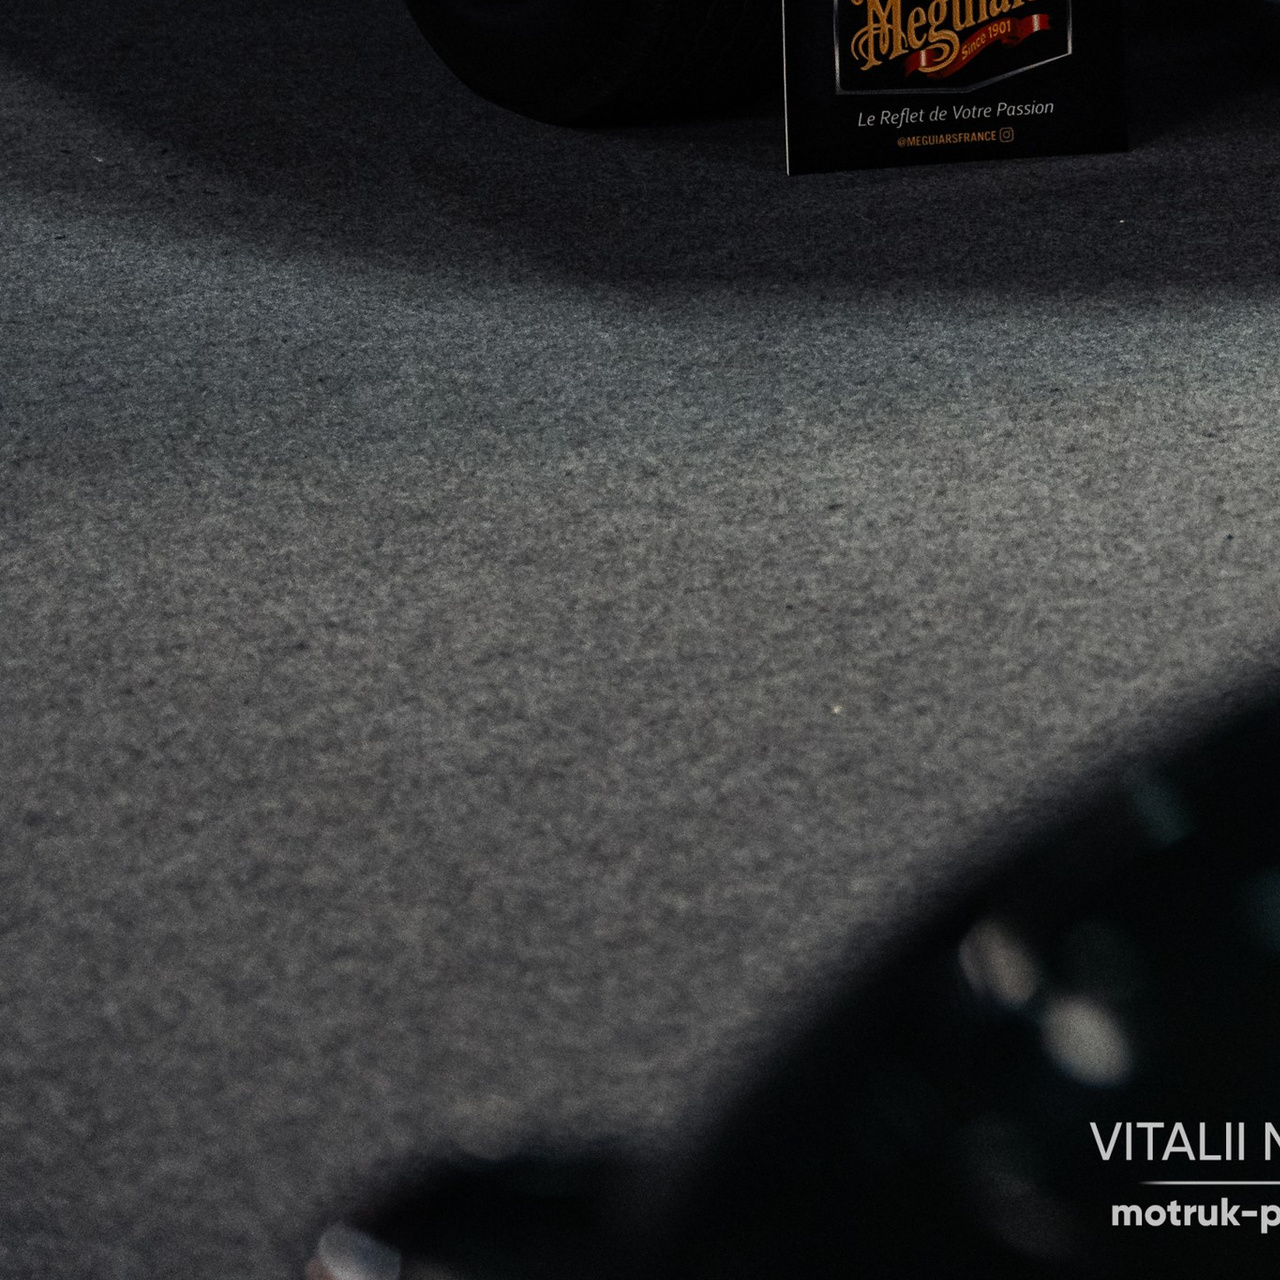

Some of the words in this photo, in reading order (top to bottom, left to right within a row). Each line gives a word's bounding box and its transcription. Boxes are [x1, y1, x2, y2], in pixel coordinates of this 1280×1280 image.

[961, 33, 987, 60] Since
[987, 20, 1012, 41] 1901
[857, 112, 875, 127] Le
[880, 108, 924, 129] Reflet
[929, 107, 947, 122] de
[952, 105, 993, 120] Votre
[996, 100, 1054, 117] Passion
[896, 130, 997, 148] @MEGUIARSFRANCE
